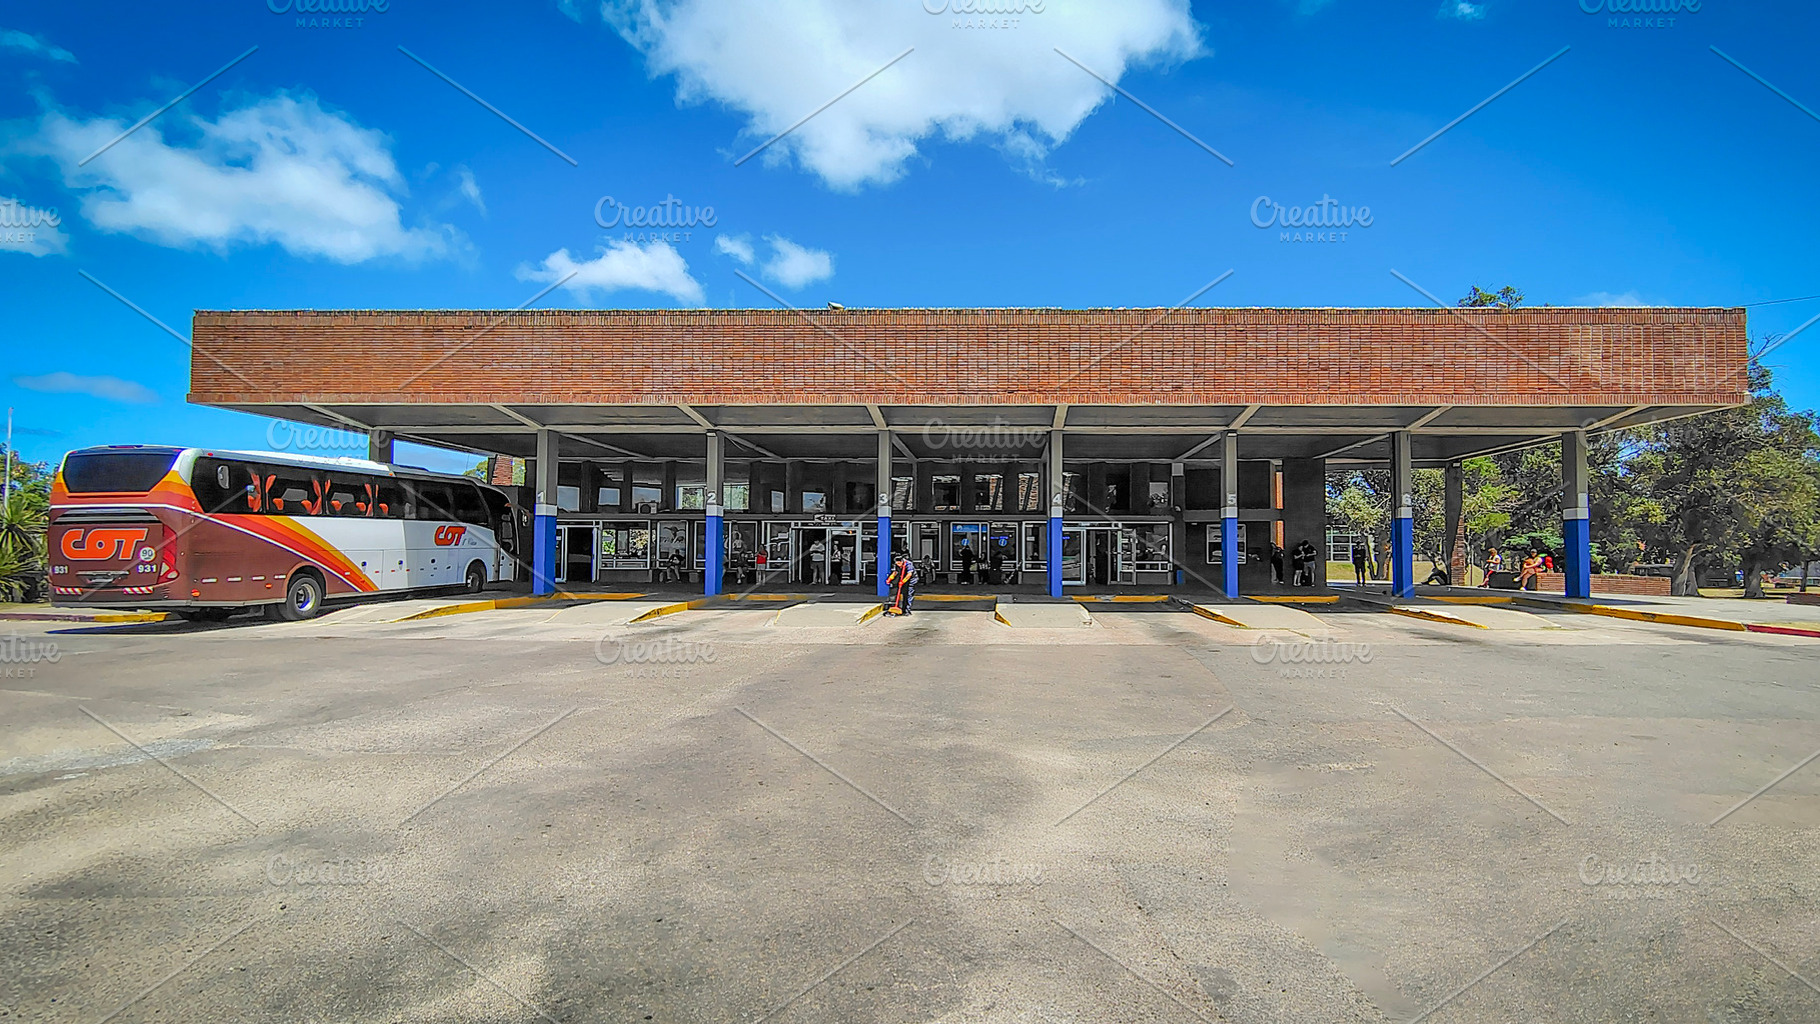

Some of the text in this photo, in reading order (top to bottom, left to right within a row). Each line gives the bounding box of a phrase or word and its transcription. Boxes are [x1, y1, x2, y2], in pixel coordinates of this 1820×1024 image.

[707, 492, 716, 503] 2
[879, 493, 888, 504] 3
[1053, 493, 1062, 504] 4
[1227, 494, 1236, 505] 5
[435, 525, 466, 546] COT
[61, 528, 148, 560] COT
[53, 565, 69, 574] 931
[137, 564, 157, 573] 931
